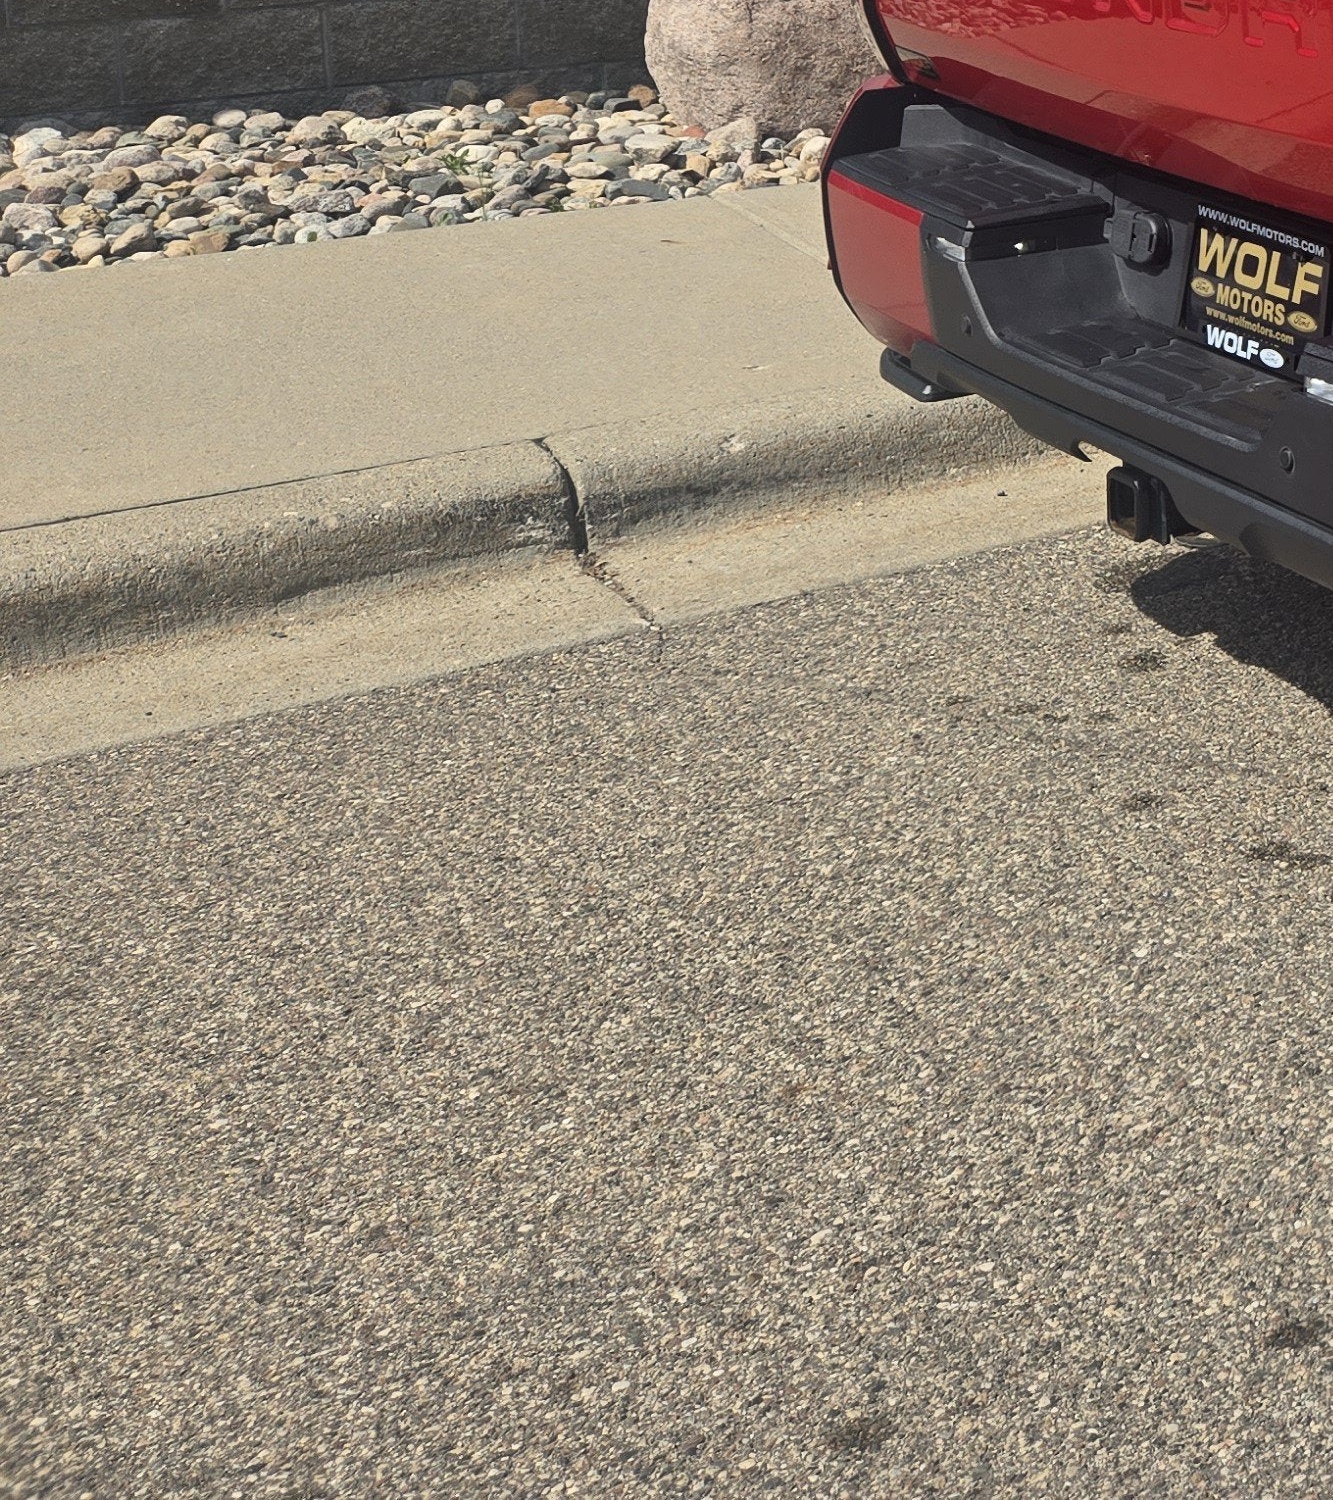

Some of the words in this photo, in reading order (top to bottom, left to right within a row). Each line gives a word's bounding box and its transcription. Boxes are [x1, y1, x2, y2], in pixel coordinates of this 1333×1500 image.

[1197, 204, 1325, 258] WWW.WOLFMOTORS.COM
[1197, 227, 1324, 305] WOLF
[1205, 305, 1295, 347] www.wolfmotors.com
[1215, 282, 1286, 327] MOTORS
[1206, 324, 1260, 361] WOLF
